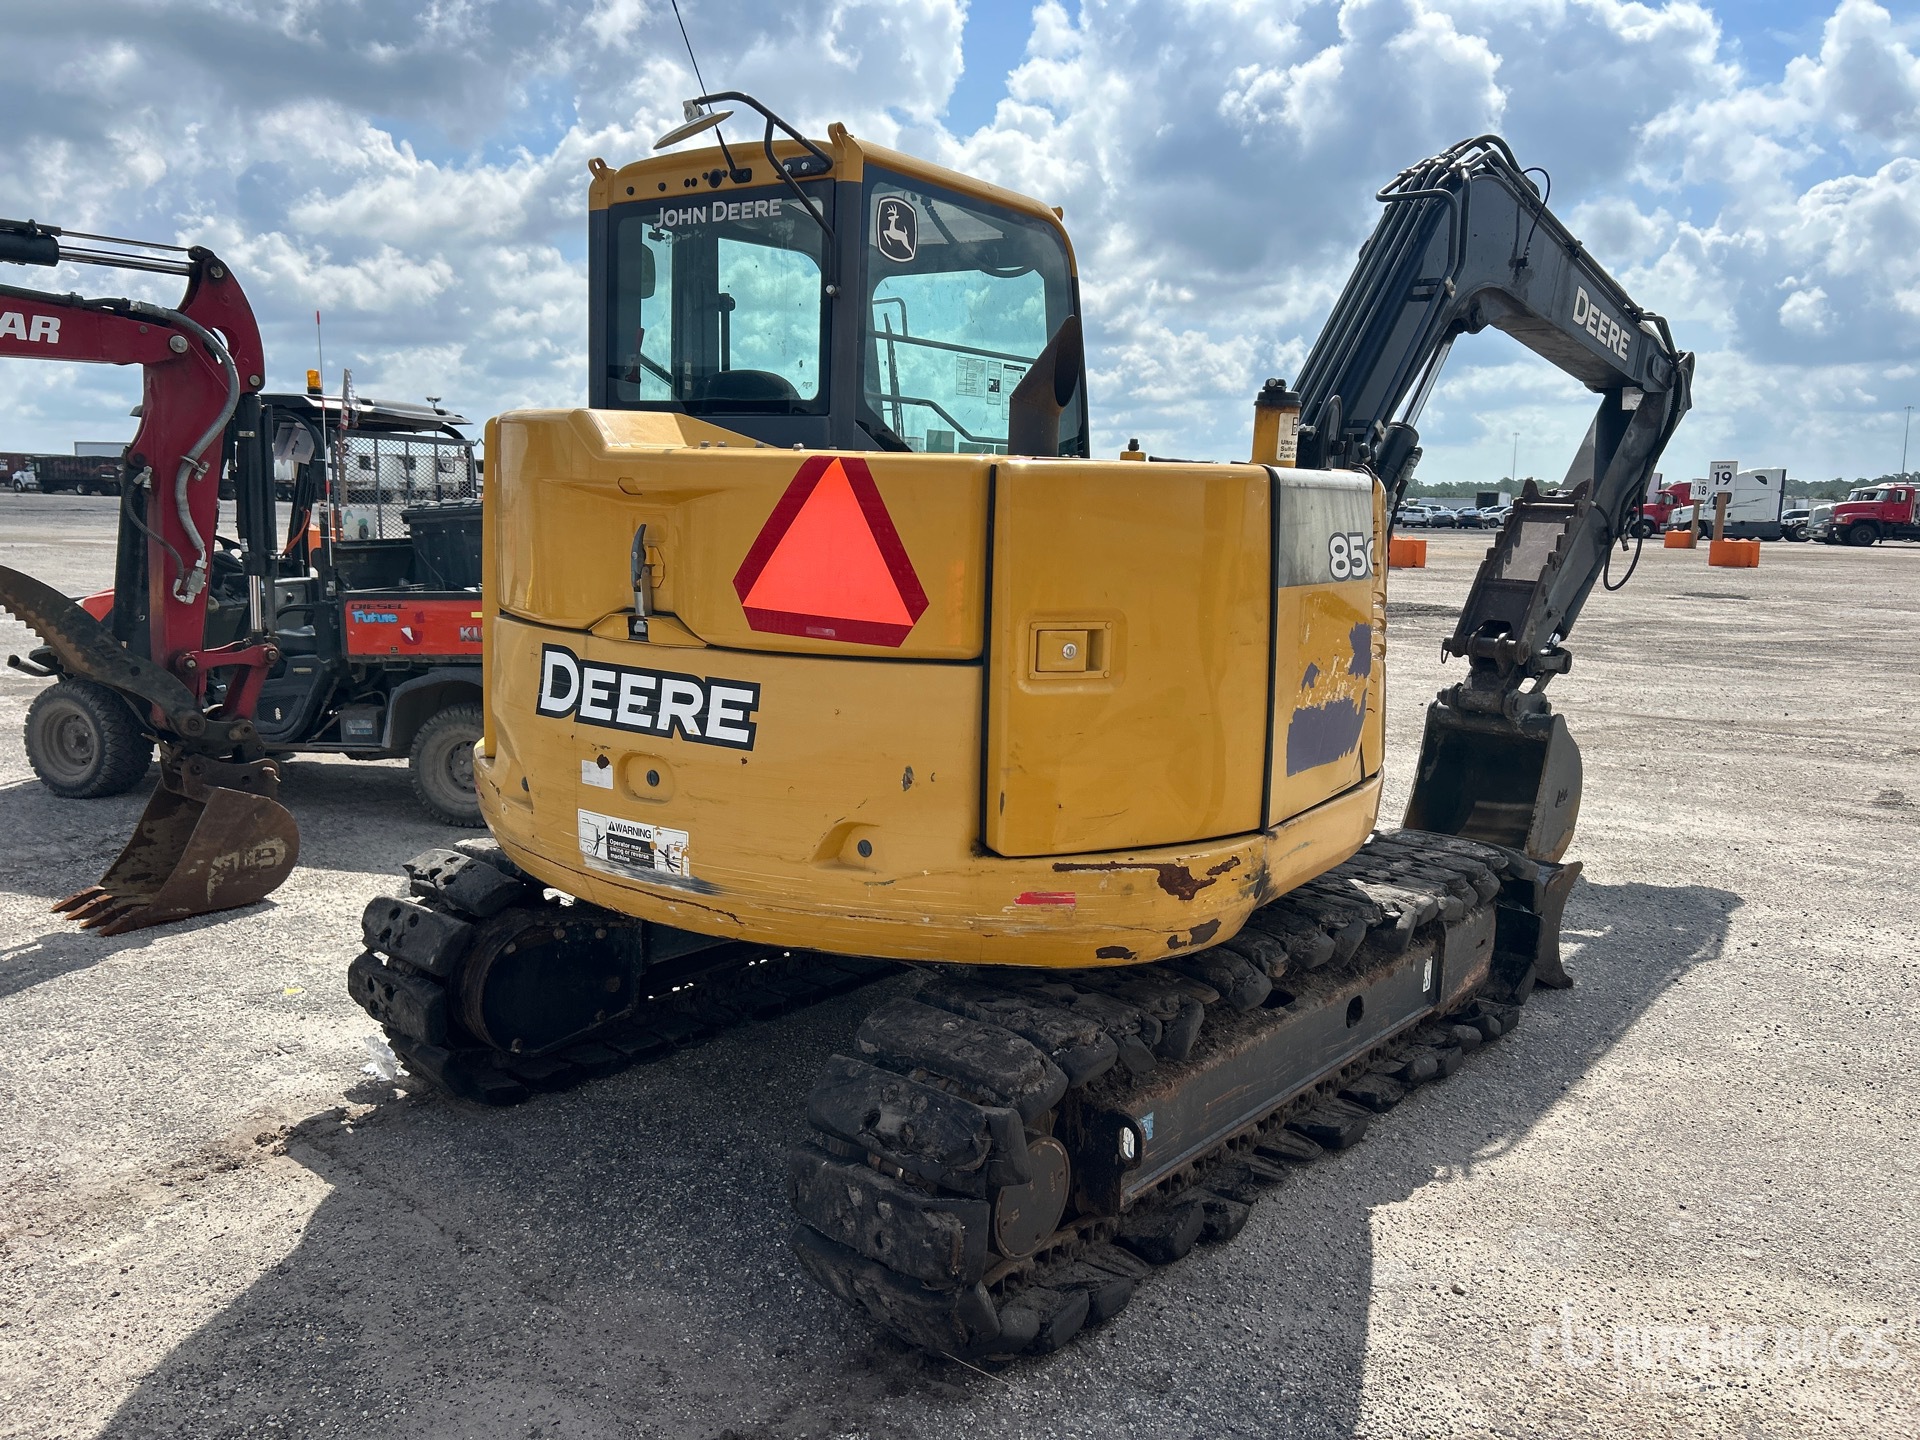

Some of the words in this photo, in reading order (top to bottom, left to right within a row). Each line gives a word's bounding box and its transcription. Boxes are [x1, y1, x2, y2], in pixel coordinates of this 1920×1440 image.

[653, 206, 706, 230] JOHN
[712, 198, 782, 222] DEERE
[1572, 285, 1631, 361] DEERE
[1714, 471, 1732, 486] 19
[1697, 485, 1707, 495] 18
[352, 609, 399, 624] Future
[538, 648, 756, 746] DEERE
[615, 822, 652, 840] WARNING
[609, 838, 630, 849] Operator
[630, 844, 642, 852] may
